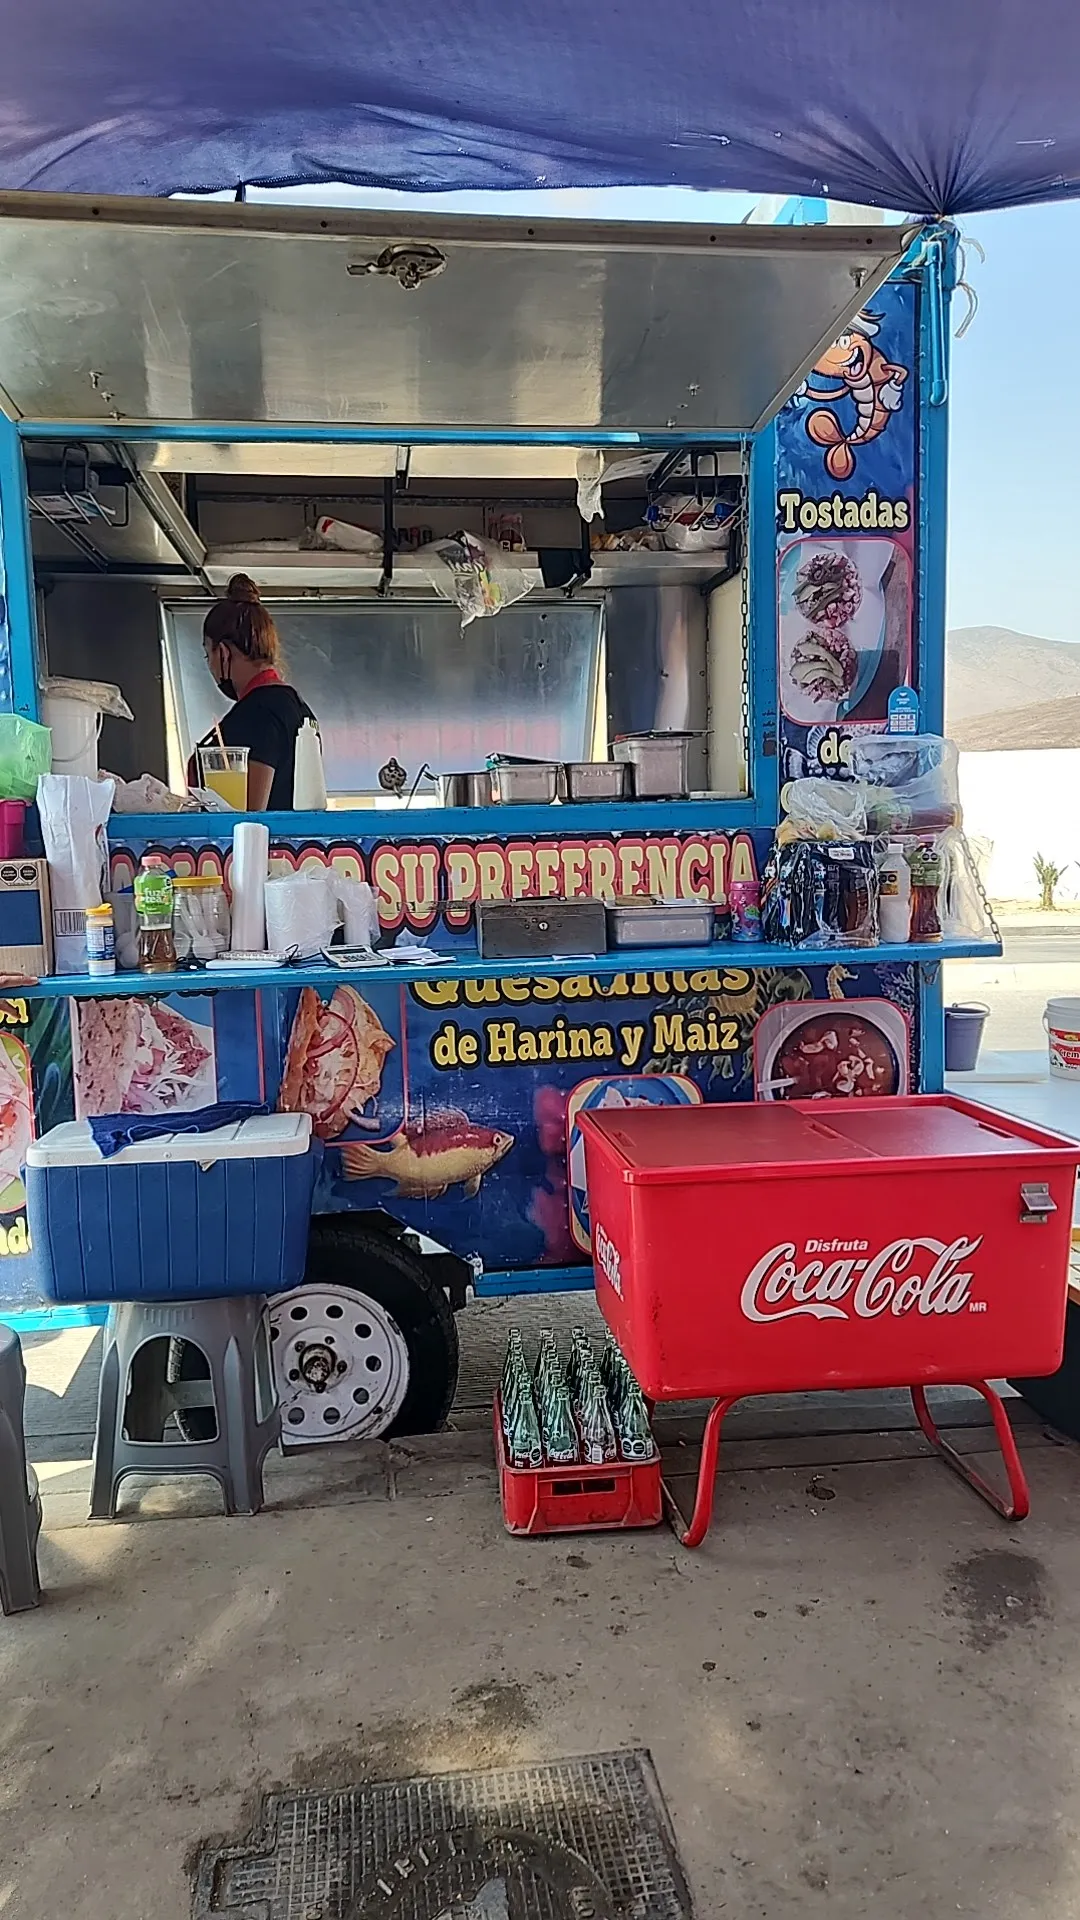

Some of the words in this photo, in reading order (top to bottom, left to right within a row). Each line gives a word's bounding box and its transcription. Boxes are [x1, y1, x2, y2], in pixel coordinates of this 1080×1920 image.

[780, 492, 909, 529] Tostadas
[374, 853, 437, 919] SU
[446, 843, 757, 917] PREFERENCIA
[433, 1025, 478, 1066] de
[487, 1020, 613, 1062] Harina
[620, 1026, 644, 1066] y
[652, 1012, 739, 1053] Maiz
[804, 1239, 869, 1253] Disfruta
[740, 1234, 984, 1322] Coca-Cola
[968, 1301, 988, 1313] MR
